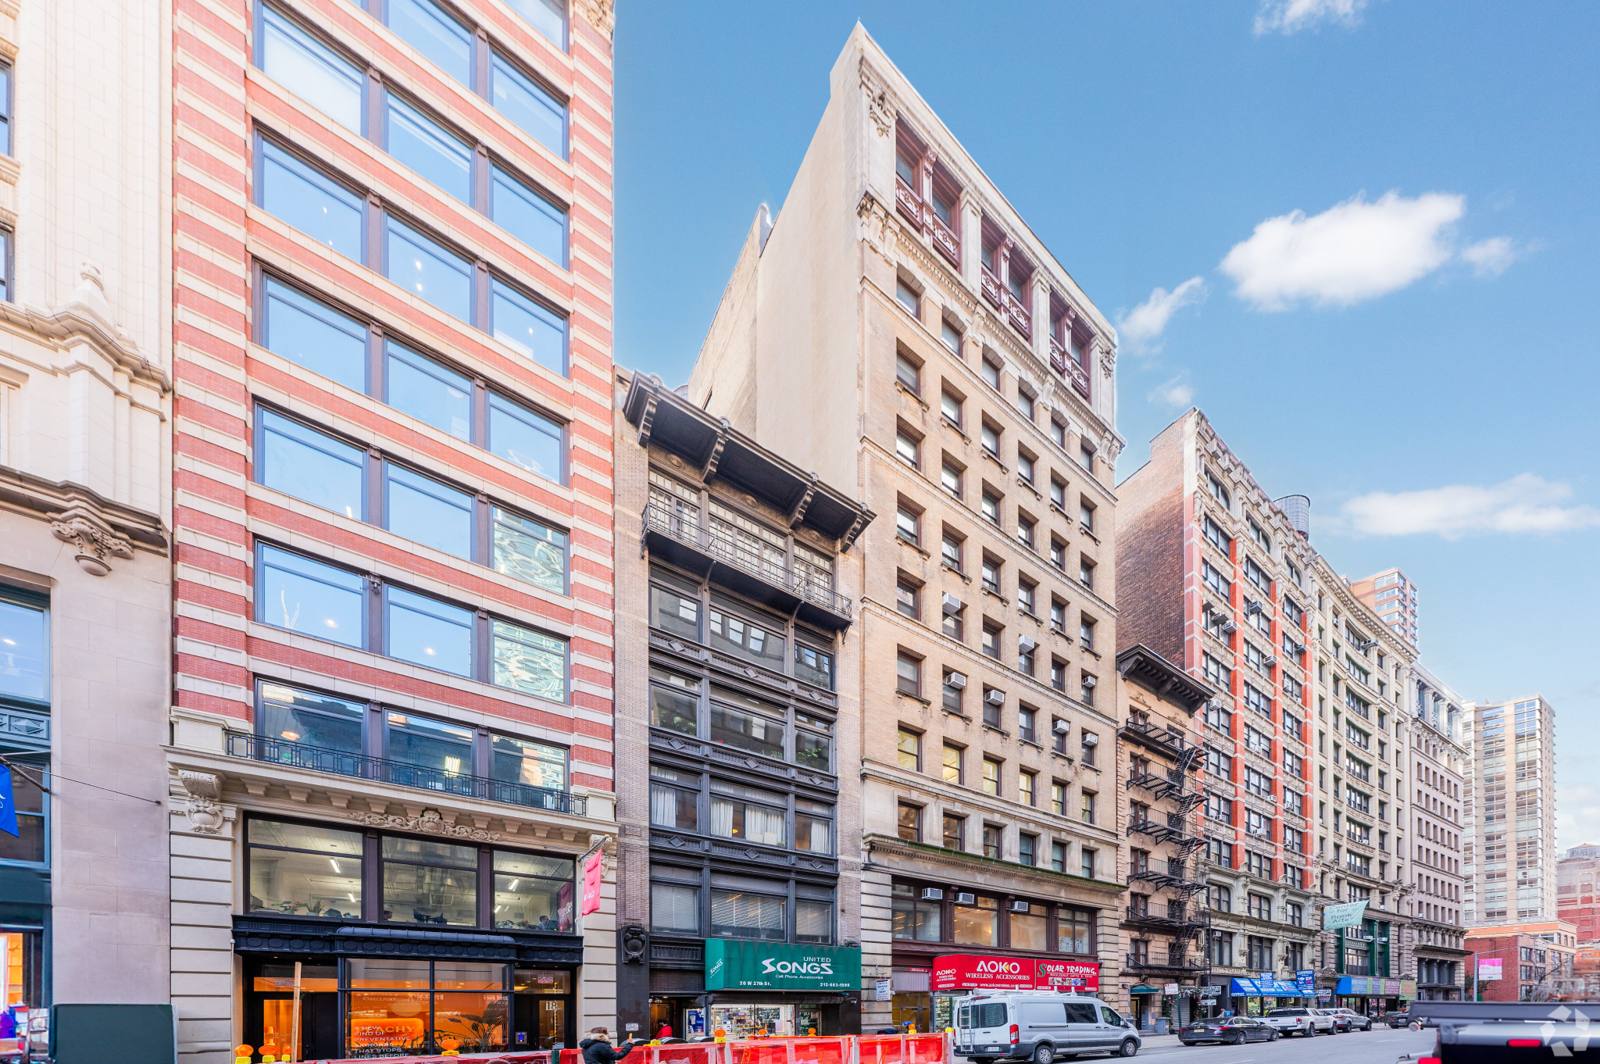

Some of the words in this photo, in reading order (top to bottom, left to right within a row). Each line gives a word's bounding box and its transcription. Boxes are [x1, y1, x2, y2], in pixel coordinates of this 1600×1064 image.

[761, 958, 833, 975] SONGS
[1037, 963, 1065, 977] SOLAR
[996, 973, 1030, 981] ACCESSORIES
